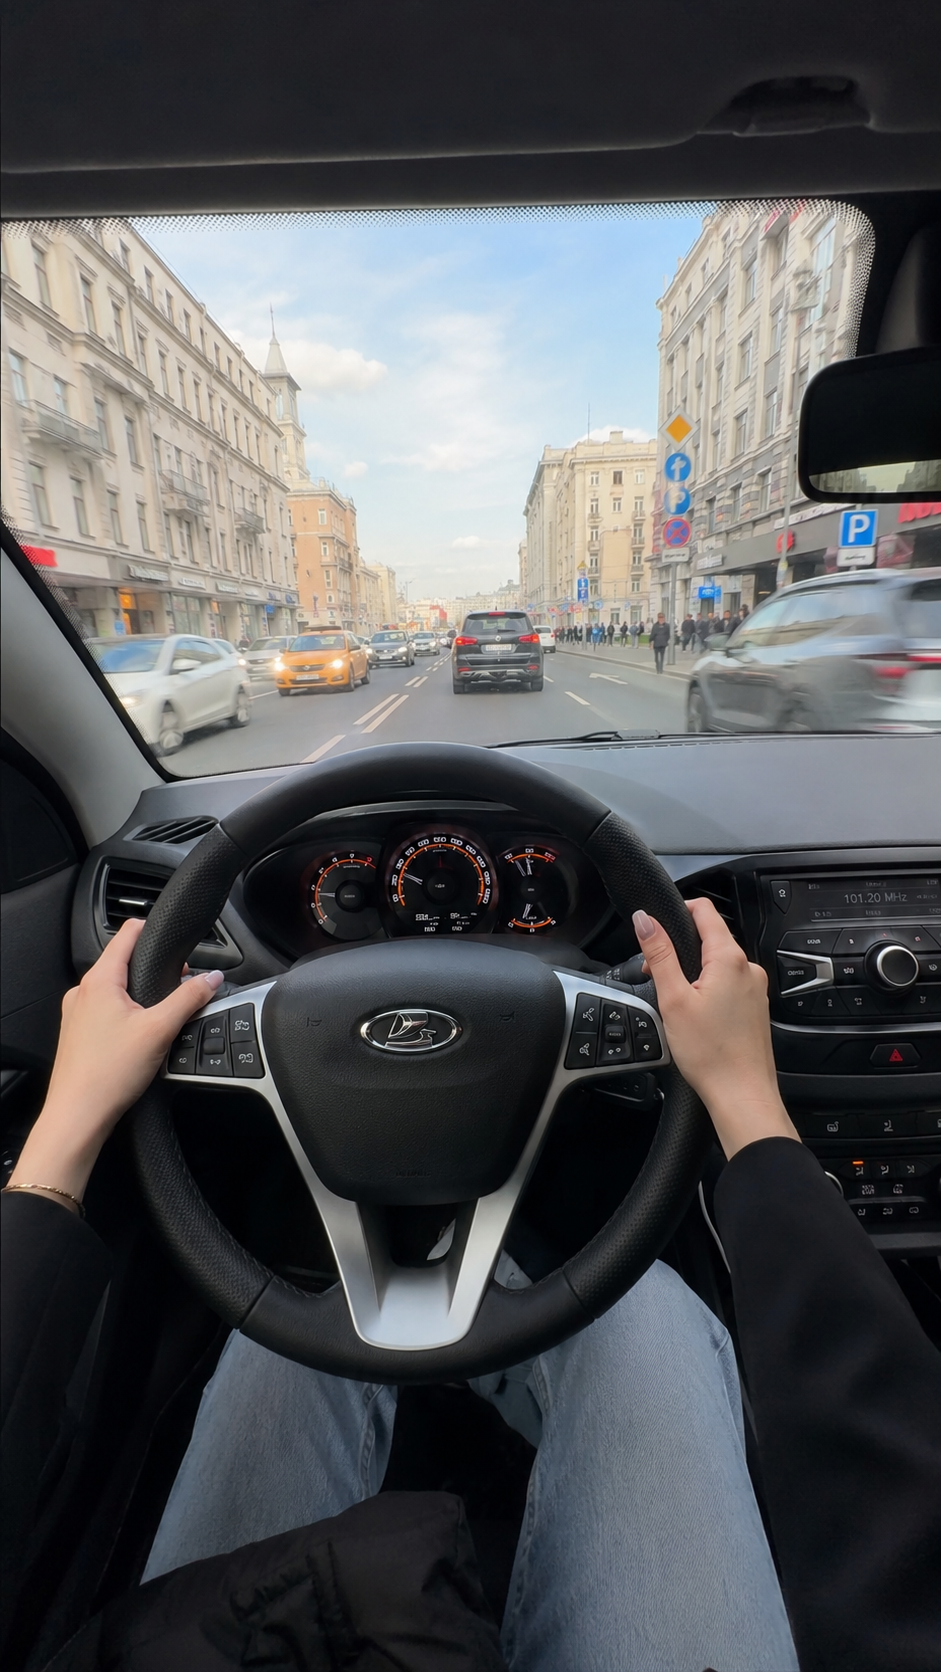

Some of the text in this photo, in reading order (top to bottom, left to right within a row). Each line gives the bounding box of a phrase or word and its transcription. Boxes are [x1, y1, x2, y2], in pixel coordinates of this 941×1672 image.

[848, 514, 870, 543] P
[844, 892, 908, 904] 101.20 MHz
